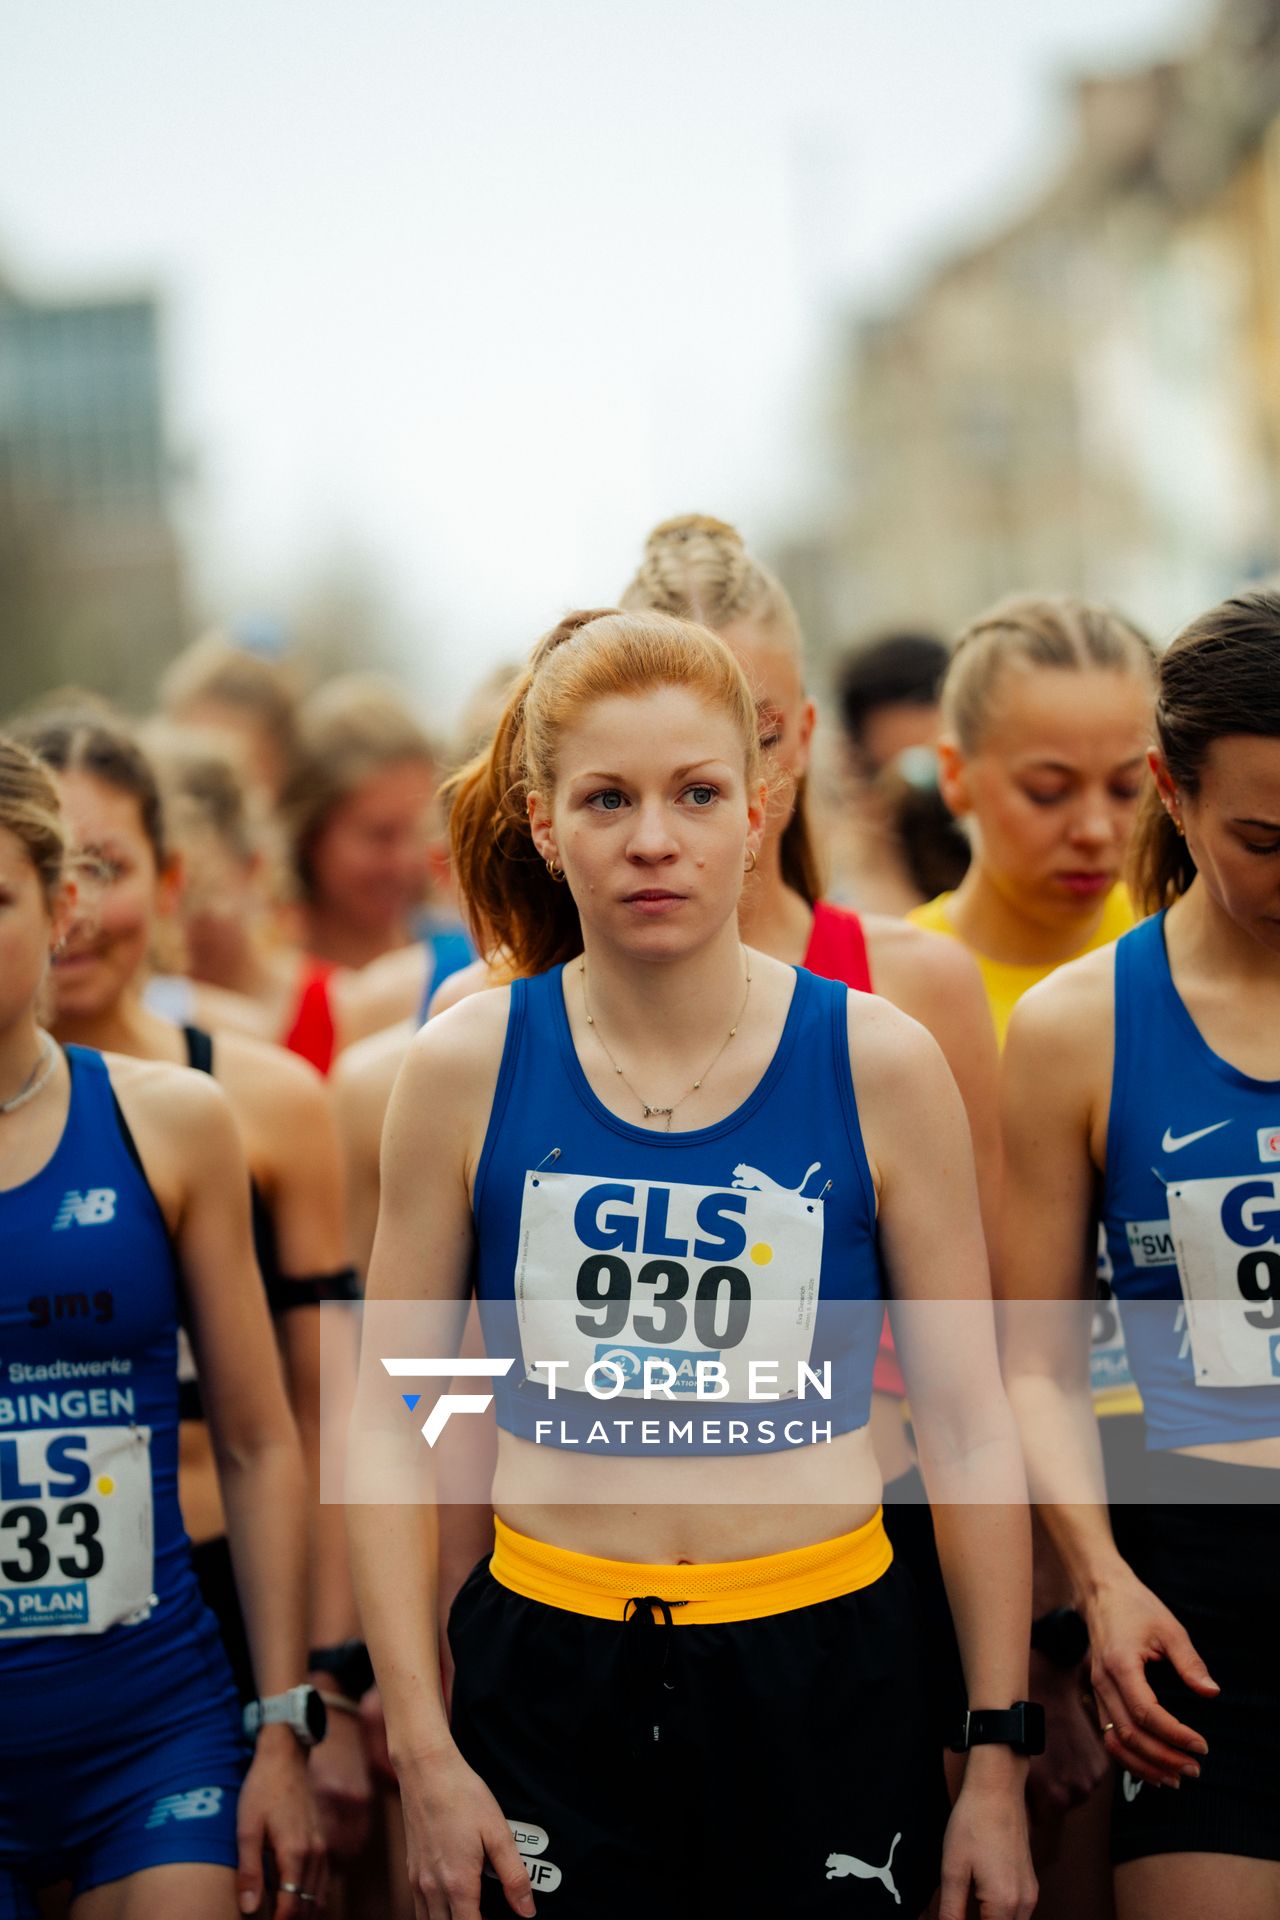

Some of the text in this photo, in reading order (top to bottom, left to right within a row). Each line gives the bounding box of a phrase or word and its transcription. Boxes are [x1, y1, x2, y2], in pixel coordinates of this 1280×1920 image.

[573, 1183, 747, 1262] GLS
[1221, 1181, 1280, 1248] G
[27, 1289, 115, 1329] gmg
[575, 1254, 752, 1349] 930
[1237, 1250, 1280, 1330] 9
[8, 1357, 132, 1384] Stadtwerke
[0, 1502, 104, 1583] 33
[18, 1591, 83, 1613] PLAN
